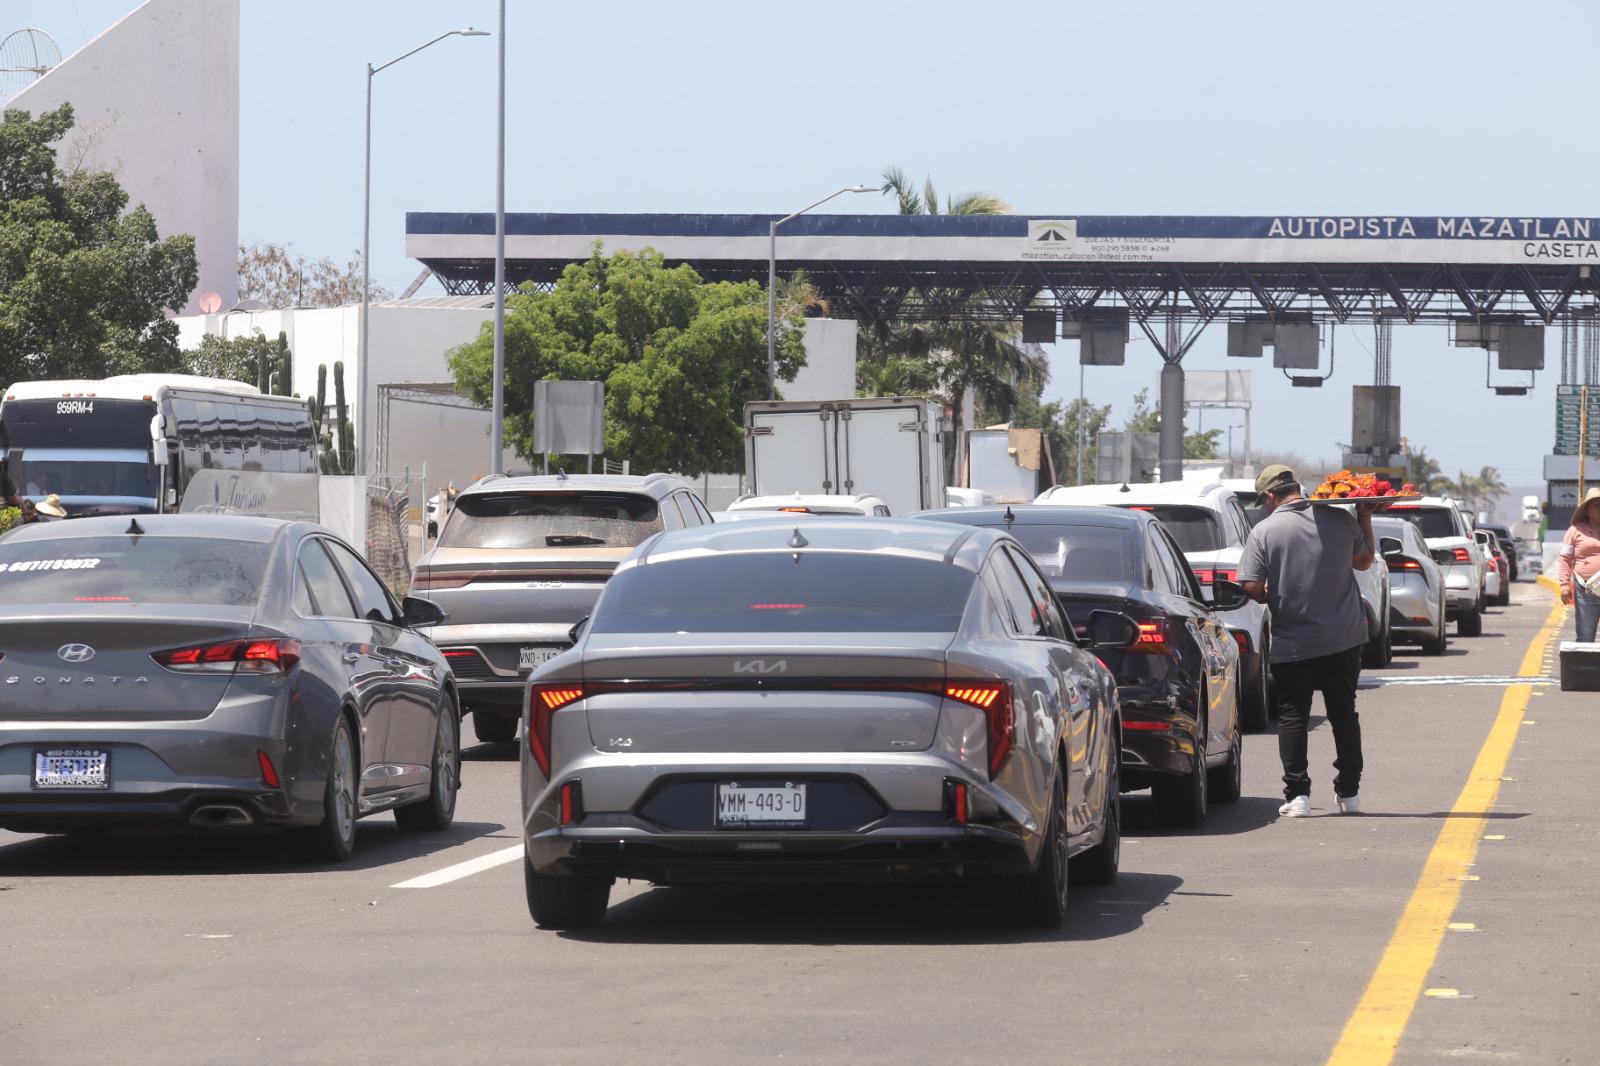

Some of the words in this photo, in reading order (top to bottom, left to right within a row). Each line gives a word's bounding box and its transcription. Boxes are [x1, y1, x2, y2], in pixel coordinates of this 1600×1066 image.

[1268, 218, 1416, 237] AUTOPISTA
[1437, 218, 1591, 239] MAZATLAN
[1524, 243, 1599, 258] CASETA
[56, 401, 94, 415] 959RM-4
[733, 659, 787, 673] KIA
[5, 675, 149, 684] SONATA
[719, 792, 802, 813] VMM-443-D
